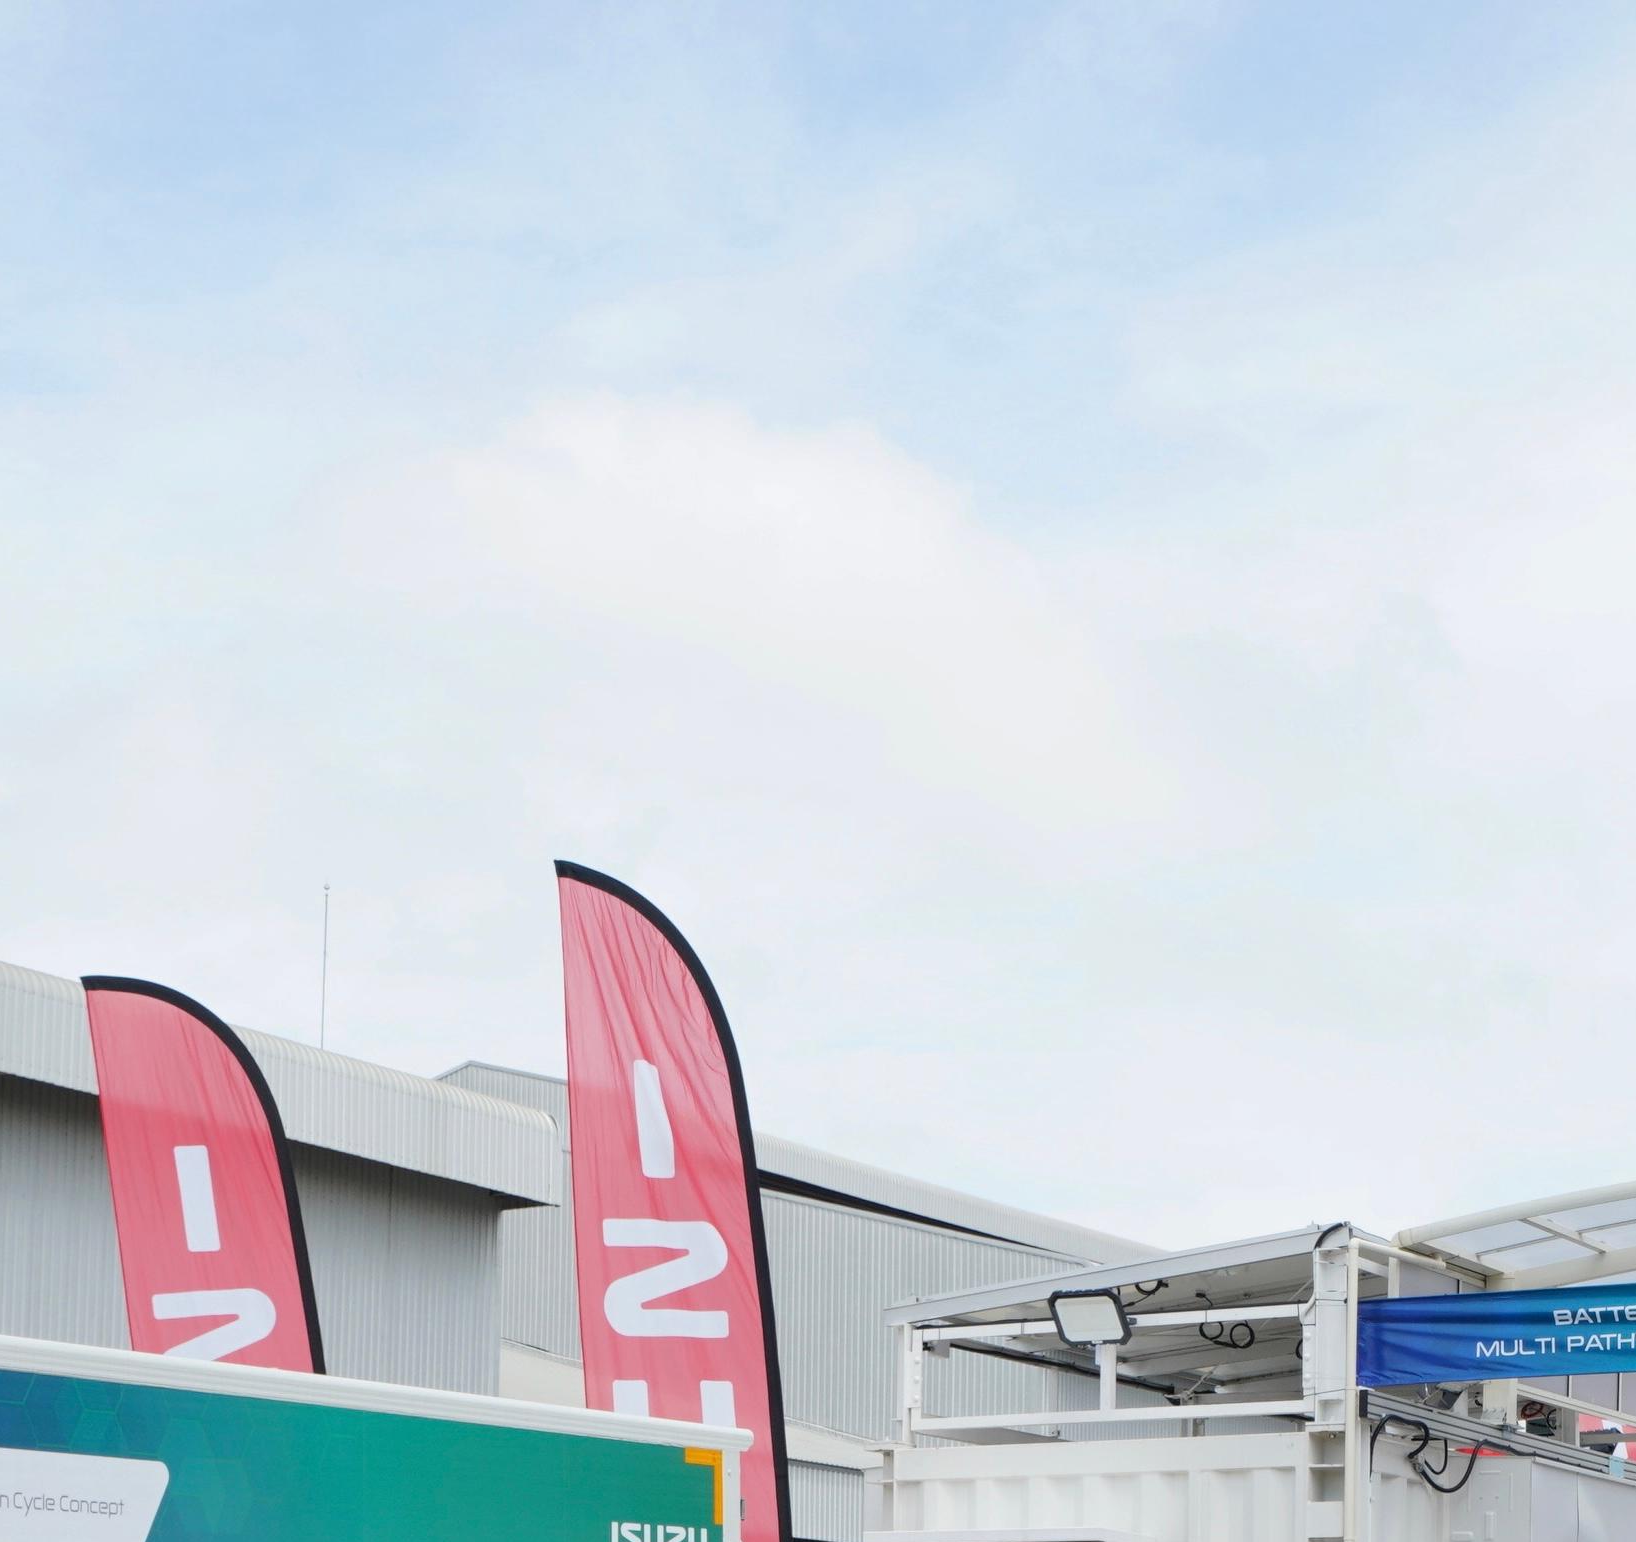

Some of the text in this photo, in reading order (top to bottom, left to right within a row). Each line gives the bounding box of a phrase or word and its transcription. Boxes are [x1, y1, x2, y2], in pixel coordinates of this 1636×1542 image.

[1476, 1337, 1556, 1358] MULTI
[13, 1492, 55, 1516] Cycle
[59, 1495, 125, 1518] Concept
